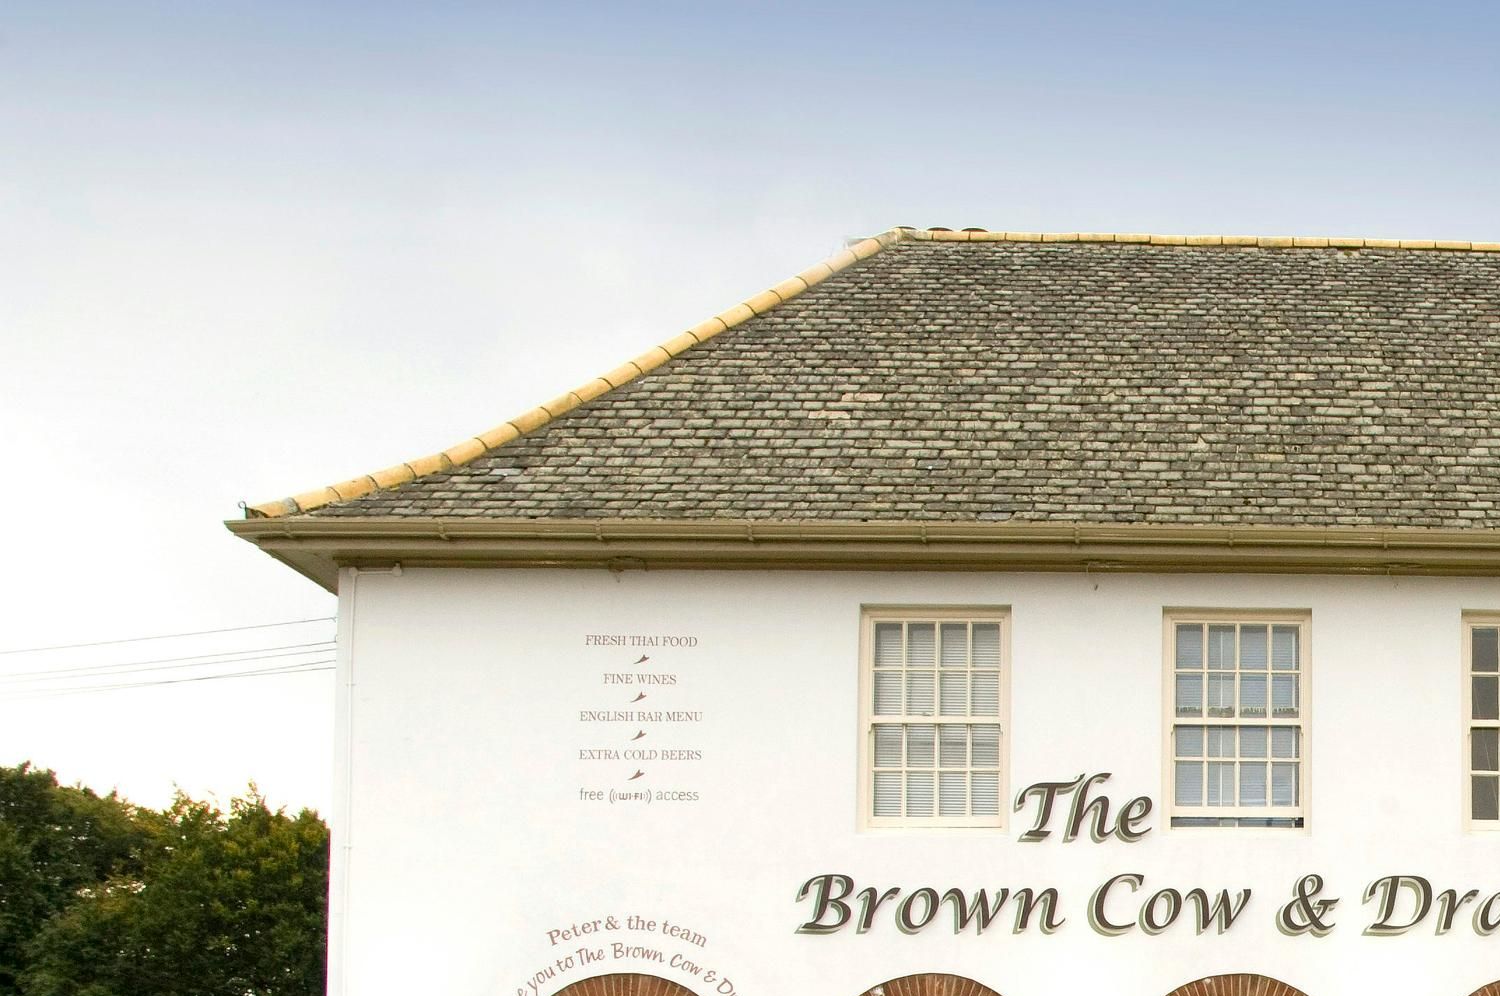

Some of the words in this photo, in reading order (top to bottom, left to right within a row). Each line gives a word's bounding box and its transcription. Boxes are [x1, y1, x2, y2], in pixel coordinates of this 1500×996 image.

[585, 635, 626, 646] FRESH
[629, 635, 659, 646] THAI
[662, 636, 698, 647] FOOD
[603, 673, 633, 685] FINE
[637, 674, 677, 685] WINES
[580, 711, 634, 722] ENGLISH
[637, 711, 663, 722] BAR
[665, 711, 703, 722] MENU
[579, 749, 620, 760] EXTRA
[624, 749, 658, 760] COLD
[661, 749, 702, 760] BEERS
[579, 787, 604, 801] free
[656, 790, 699, 801] access
[1014, 770, 1154, 845] The
[794, 872, 1066, 937] Brown
[1086, 872, 1252, 937] Cow
[1275, 873, 1341, 937] &
[546, 918, 602, 947] Peter
[605, 915, 620, 930] &
[627, 915, 657, 932] the
[662, 919, 708, 948] team
[528, 966, 557, 996] you
[555, 956, 575, 973] to
[576, 948, 605, 967] The
[610, 942, 665, 963] Brown
[669, 953, 703, 976] Cow
[703, 970, 717, 983] &
